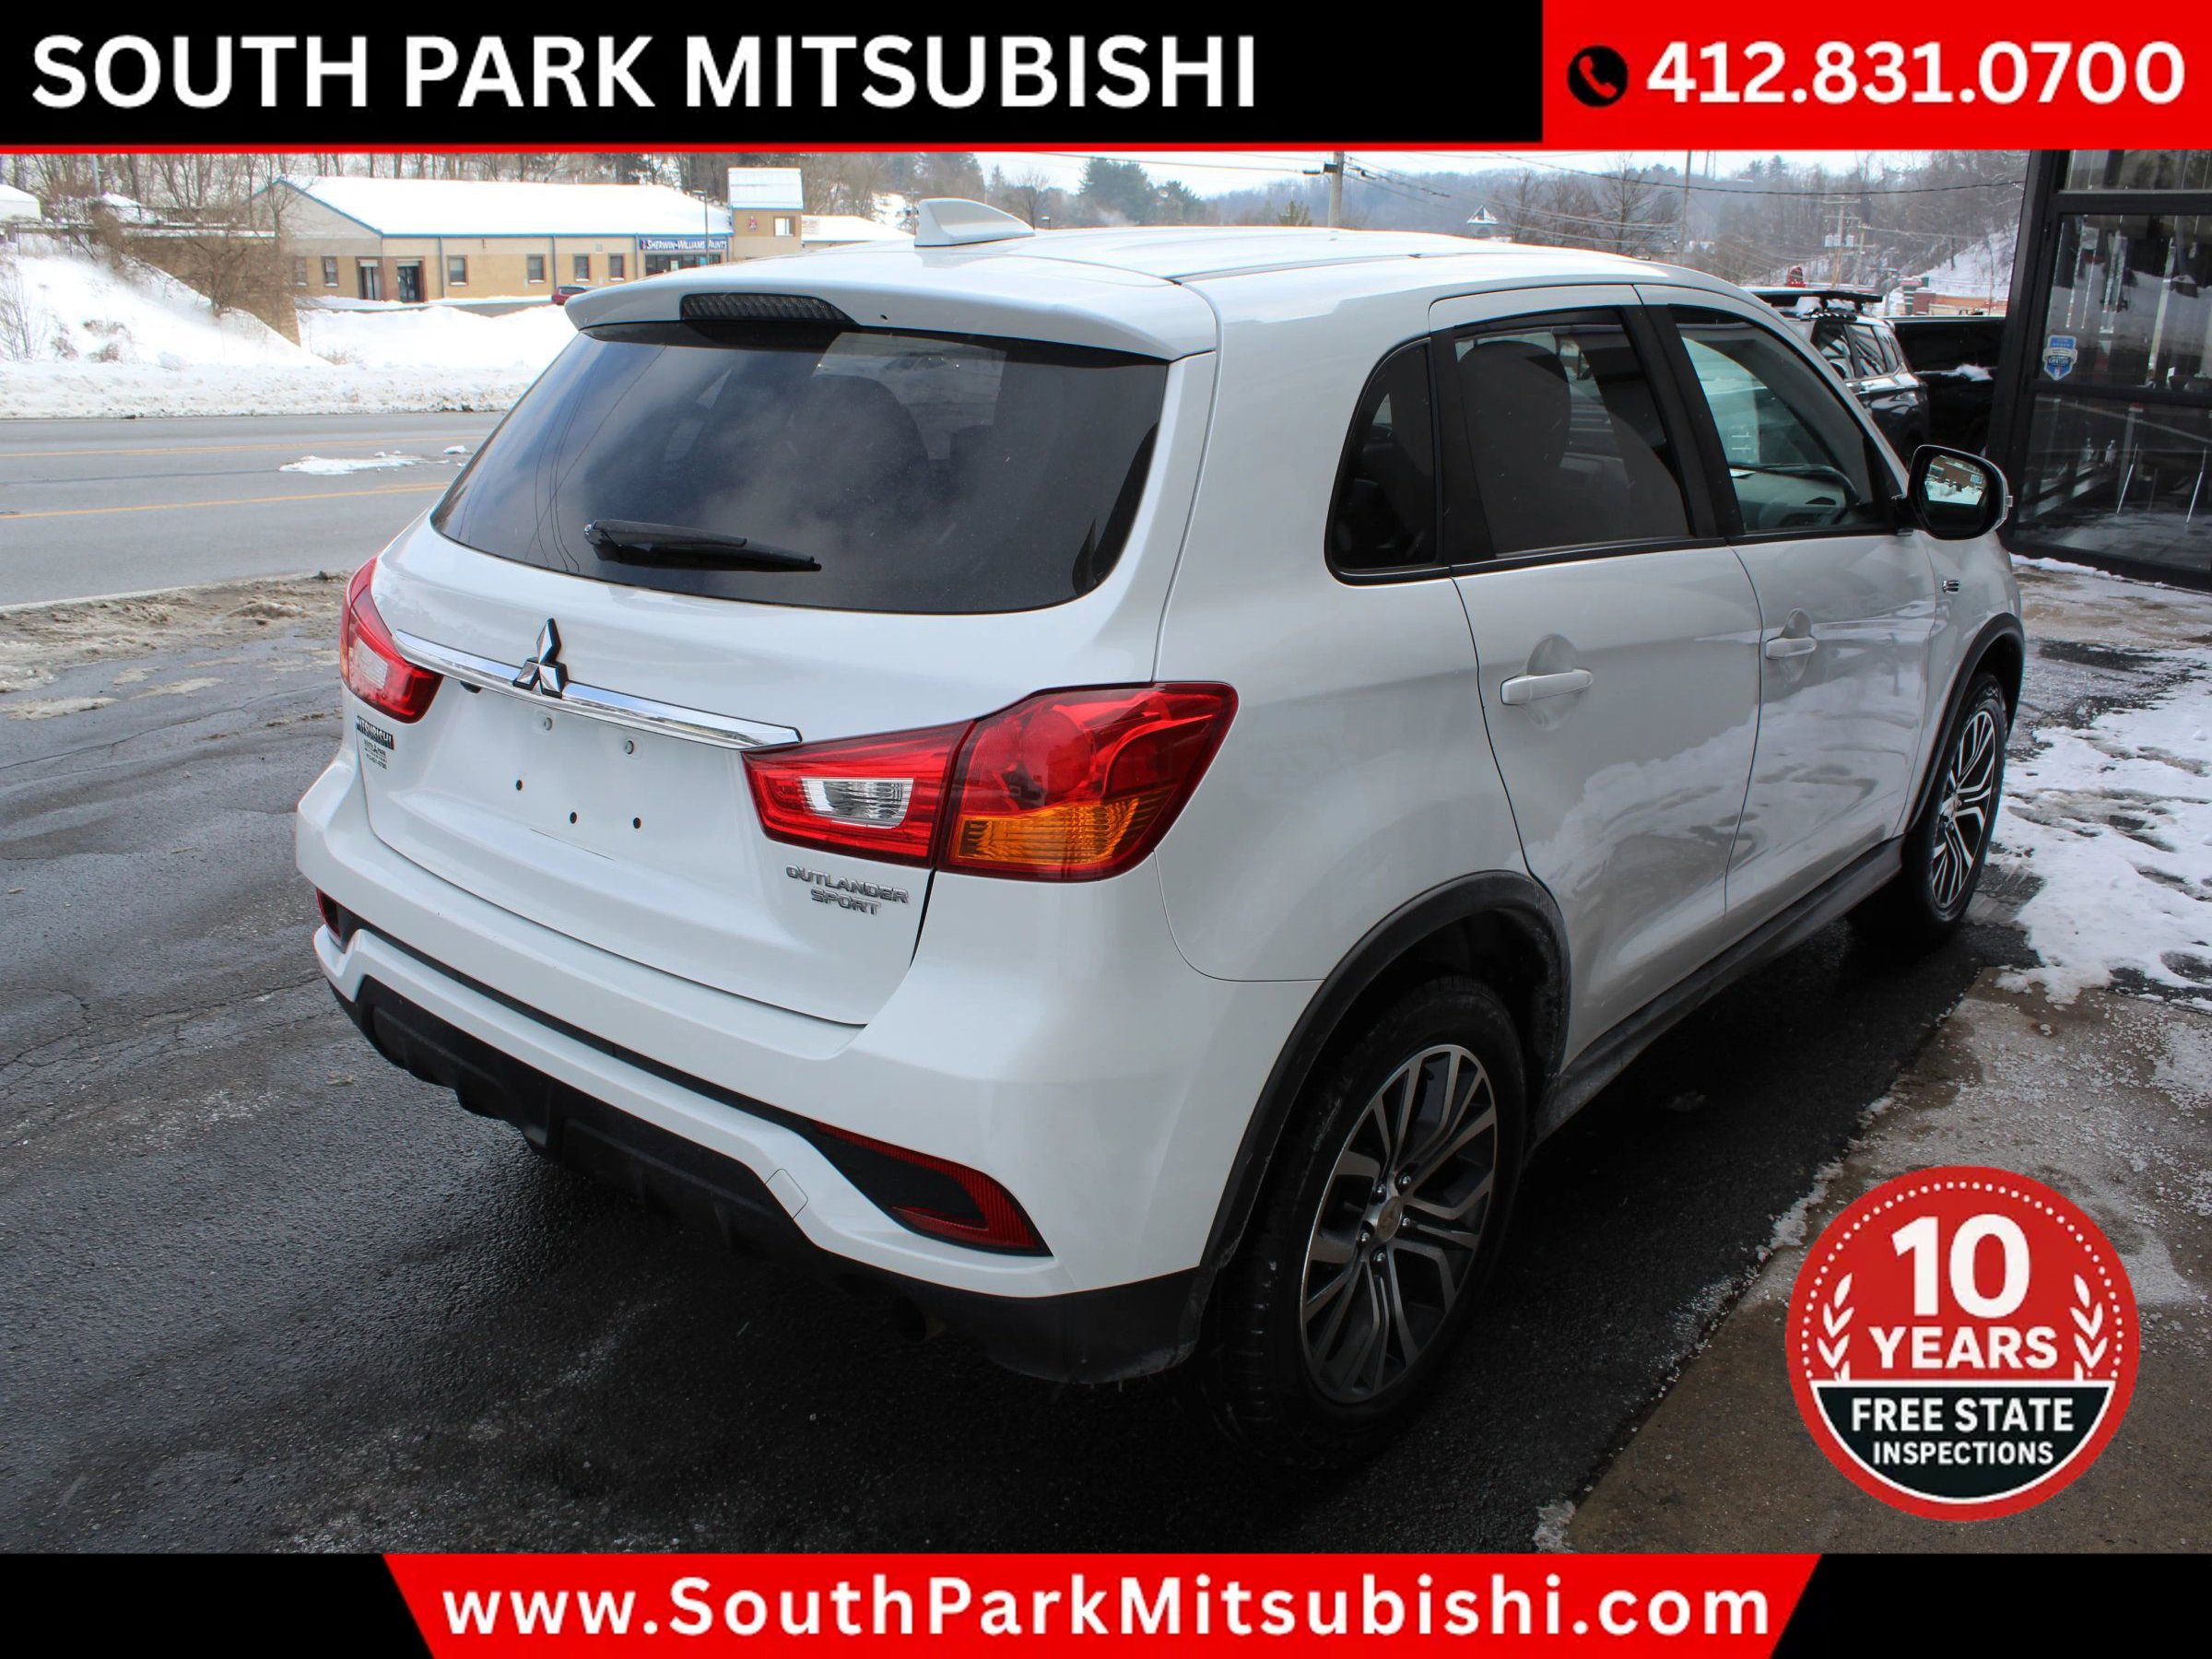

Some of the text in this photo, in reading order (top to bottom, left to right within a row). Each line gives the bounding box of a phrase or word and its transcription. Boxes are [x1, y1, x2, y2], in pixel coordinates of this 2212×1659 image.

[708, 239, 727, 250] PAINTS
[786, 864, 909, 904] OUTLANDER
[811, 888, 881, 915] SPORT
